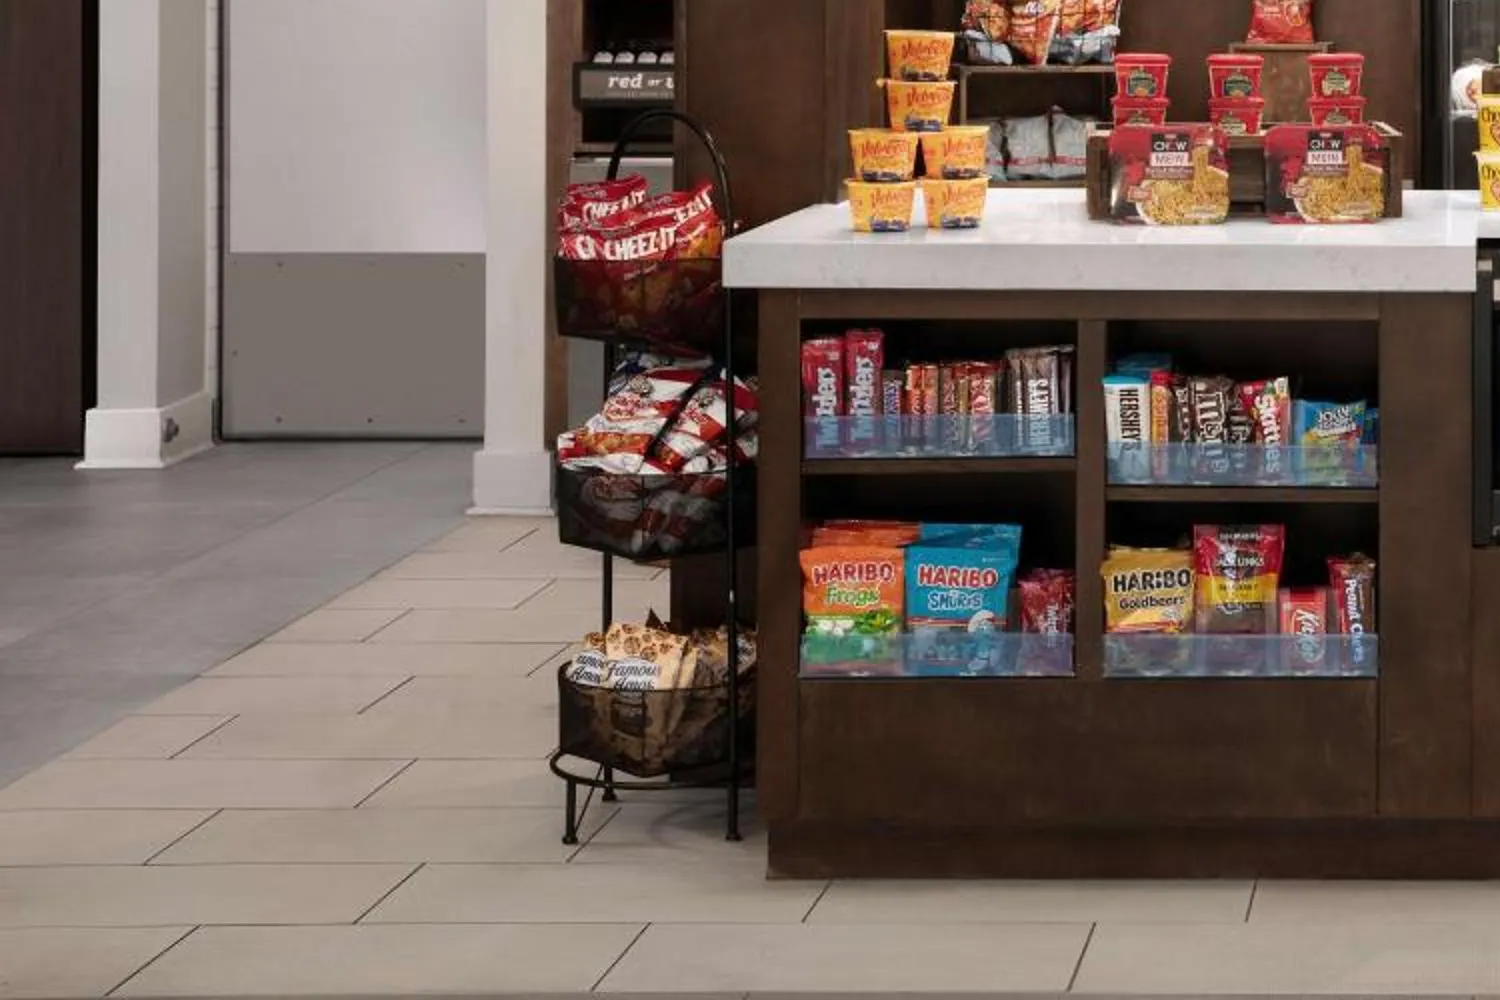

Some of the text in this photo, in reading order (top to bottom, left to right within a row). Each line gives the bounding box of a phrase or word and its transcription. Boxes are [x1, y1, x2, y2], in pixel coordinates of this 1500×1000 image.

[607, 73, 643, 89] red
[812, 561, 895, 587] HARIBO
[917, 563, 998, 589] HARIBO
[1113, 568, 1191, 593] HARIBO
